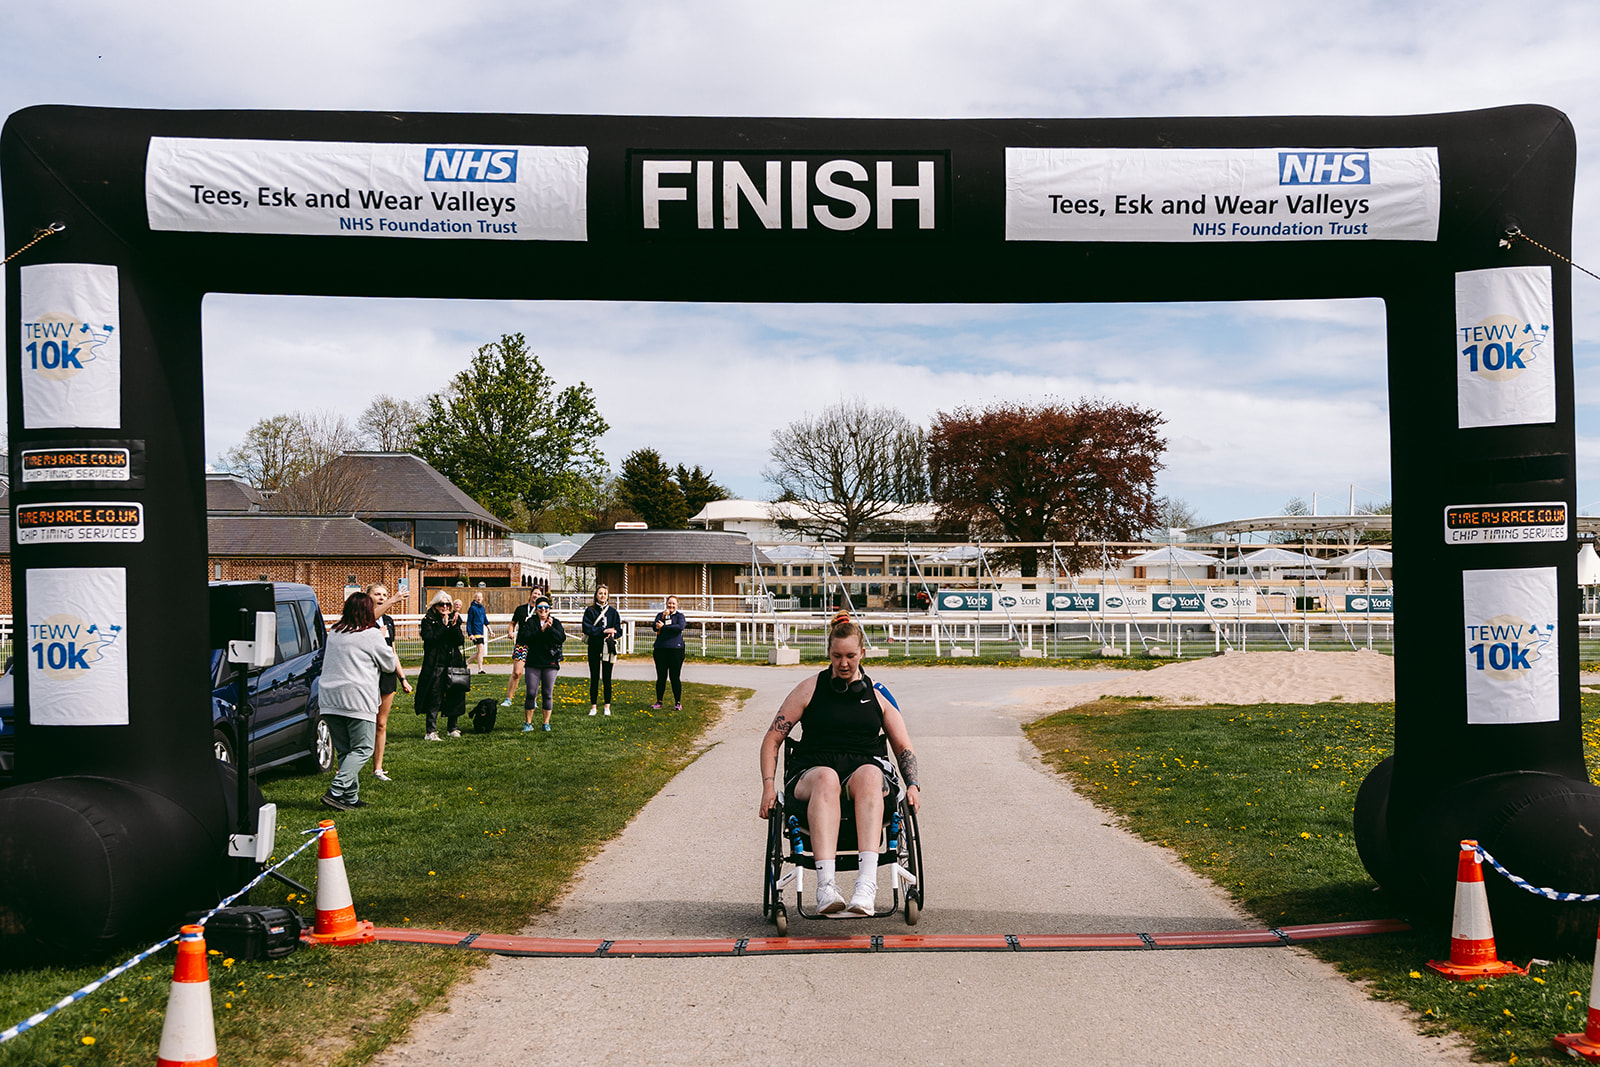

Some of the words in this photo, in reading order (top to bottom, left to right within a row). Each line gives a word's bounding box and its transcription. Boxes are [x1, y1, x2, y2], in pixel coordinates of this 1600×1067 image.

[426, 150, 515, 180] NHS
[1281, 154, 1366, 183] NHS
[190, 185, 249, 208] Tees,
[258, 187, 297, 207] Esk
[305, 188, 350, 208] and
[358, 190, 423, 210] Wear
[431, 191, 516, 217] Valleys
[642, 159, 935, 231] FINISH
[1048, 194, 1106, 217] Tees,
[1115, 194, 1153, 214] Esk
[1161, 194, 1206, 214] and
[1214, 195, 1278, 214] Wear
[1286, 193, 1369, 219] Valleys
[339, 217, 374, 231] NHS
[379, 218, 472, 233] Foundation
[477, 220, 518, 234] Trust
[1193, 222, 1226, 236] NHS
[1232, 222, 1323, 236] Foundation
[1329, 222, 1368, 235] Trust
[24, 322, 74, 339] TEWV
[1460, 324, 1517, 342] TEWV
[25, 340, 84, 369] 10k
[1462, 341, 1527, 372] 10k
[76, 468, 125, 478] SERVICES
[41, 528, 74, 539] TIMING
[78, 527, 137, 539] SERVICES
[1452, 530, 1478, 541] CHIP
[1483, 528, 1519, 540] TIMING
[1522, 527, 1564, 539] SERVICES
[1020, 596, 1041, 606] York
[1126, 597, 1147, 606] York
[1178, 597, 1200, 606] York
[1230, 597, 1252, 607] York
[1371, 598, 1392, 608] York
[30, 624, 80, 640] TEWV
[1467, 624, 1523, 641] TEWV
[31, 641, 91, 670] 10k
[1469, 642, 1532, 670] 10k
